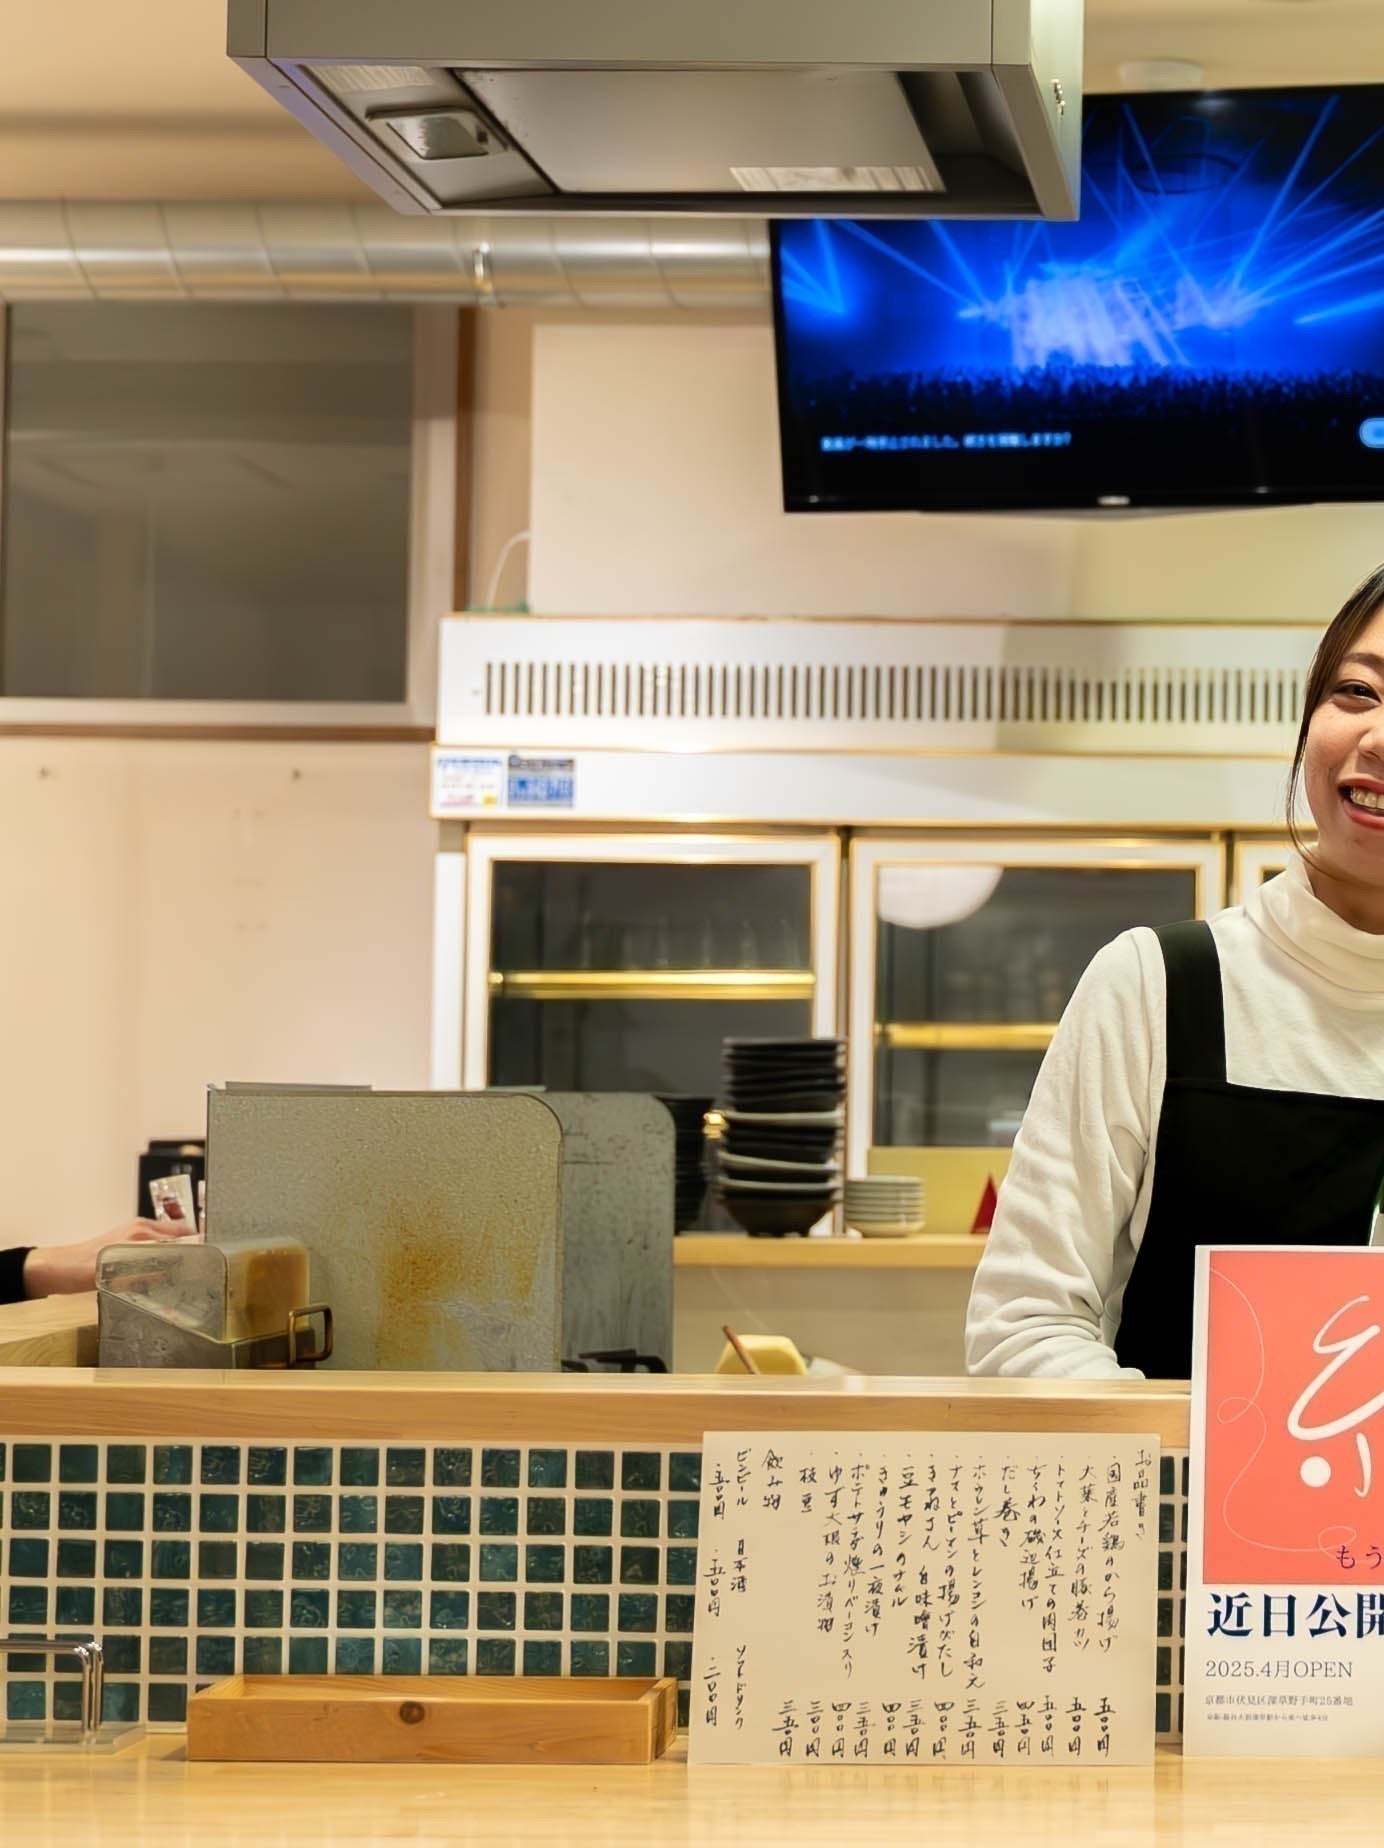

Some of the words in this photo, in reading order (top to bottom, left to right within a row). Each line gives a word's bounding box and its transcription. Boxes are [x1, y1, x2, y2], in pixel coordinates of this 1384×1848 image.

[736, 1448, 752, 1506] ビンビール
[761, 1449, 784, 1511] 飲み物
[800, 1467, 817, 1513] 枝豆
[993, 1465, 1020, 1547] だし巻き
[1132, 1448, 1152, 1540] お品書き
[730, 1539, 748, 1592] 日本酒
[891, 1466, 919, 1608] 豆モヤシのナムル
[1205, 1659, 1353, 1679] 2025.4月OPEN
